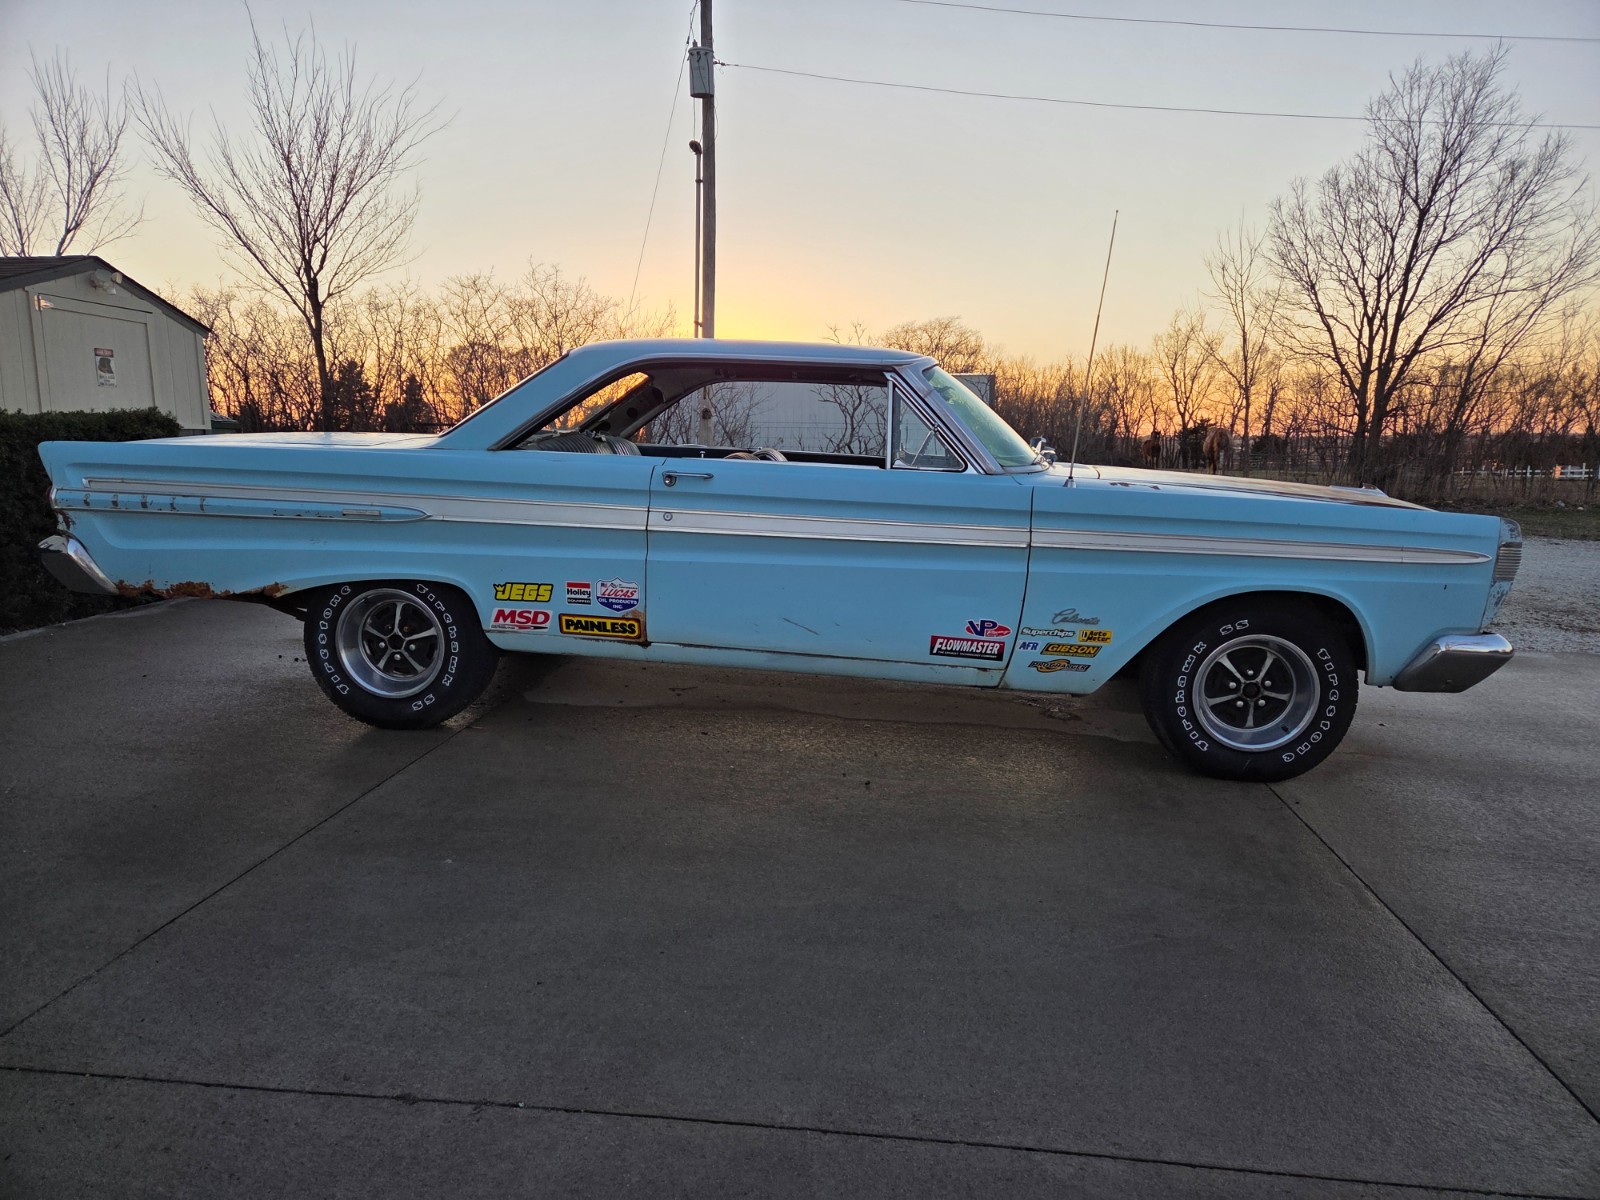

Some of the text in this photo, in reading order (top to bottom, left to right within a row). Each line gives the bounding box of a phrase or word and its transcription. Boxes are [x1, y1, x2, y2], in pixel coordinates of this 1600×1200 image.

[496, 583, 553, 602] JEGS
[567, 588, 591, 598] Holley
[602, 589, 637, 598] LUCAS
[494, 609, 550, 625] MSD
[565, 618, 637, 635] PAINLESS
[968, 619, 998, 637] VP
[1021, 627, 1075, 638] Superchips
[1219, 619, 1250, 636] SS
[317, 585, 352, 696] Firestone
[933, 638, 1000, 655] FLOWMASTER
[1019, 642, 1038, 651] AFR
[1048, 644, 1098, 654] GIBSON
[411, 693, 436, 712] SS
[1282, 647, 1339, 763] Firestone
